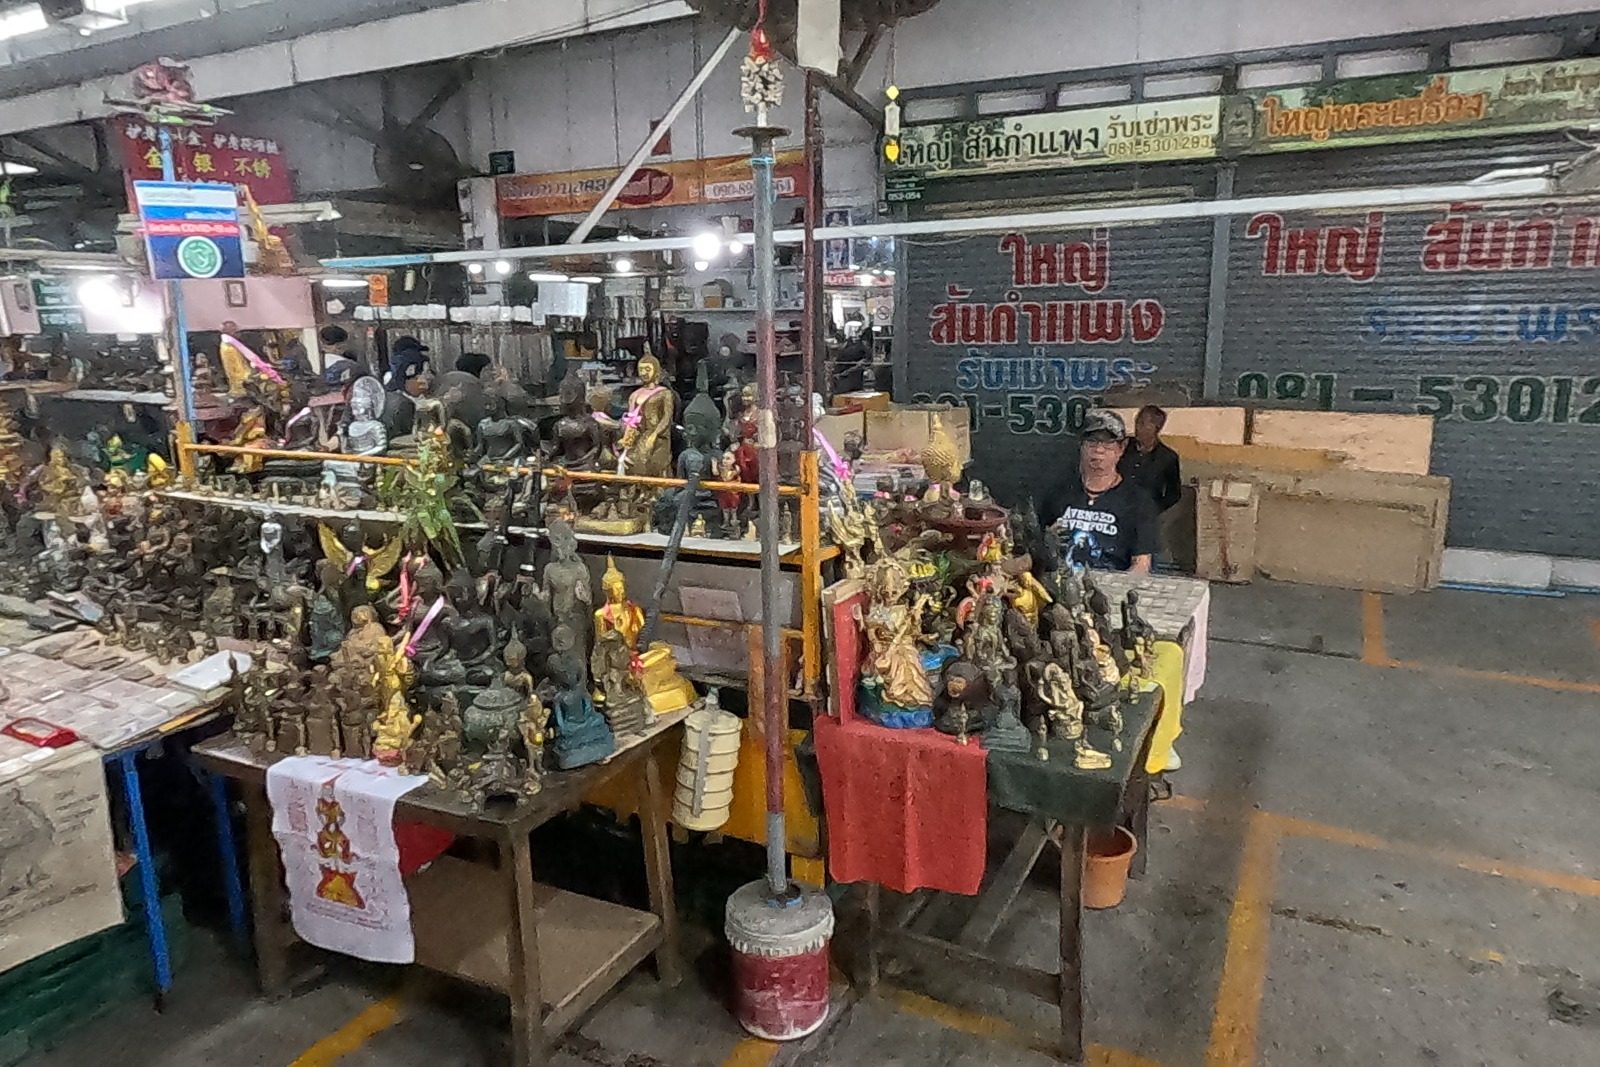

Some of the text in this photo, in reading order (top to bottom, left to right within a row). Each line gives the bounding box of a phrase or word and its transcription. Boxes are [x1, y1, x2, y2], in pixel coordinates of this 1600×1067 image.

[962, 122, 1100, 161] สันกำแพง
[1106, 111, 1214, 140] รับเช่าพระ
[998, 227, 1110, 293] ใหญ่
[1245, 211, 1385, 283] ใหญ่
[928, 281, 1167, 346] สันกำแพง
[1062, 506, 1117, 524] AVENGED
